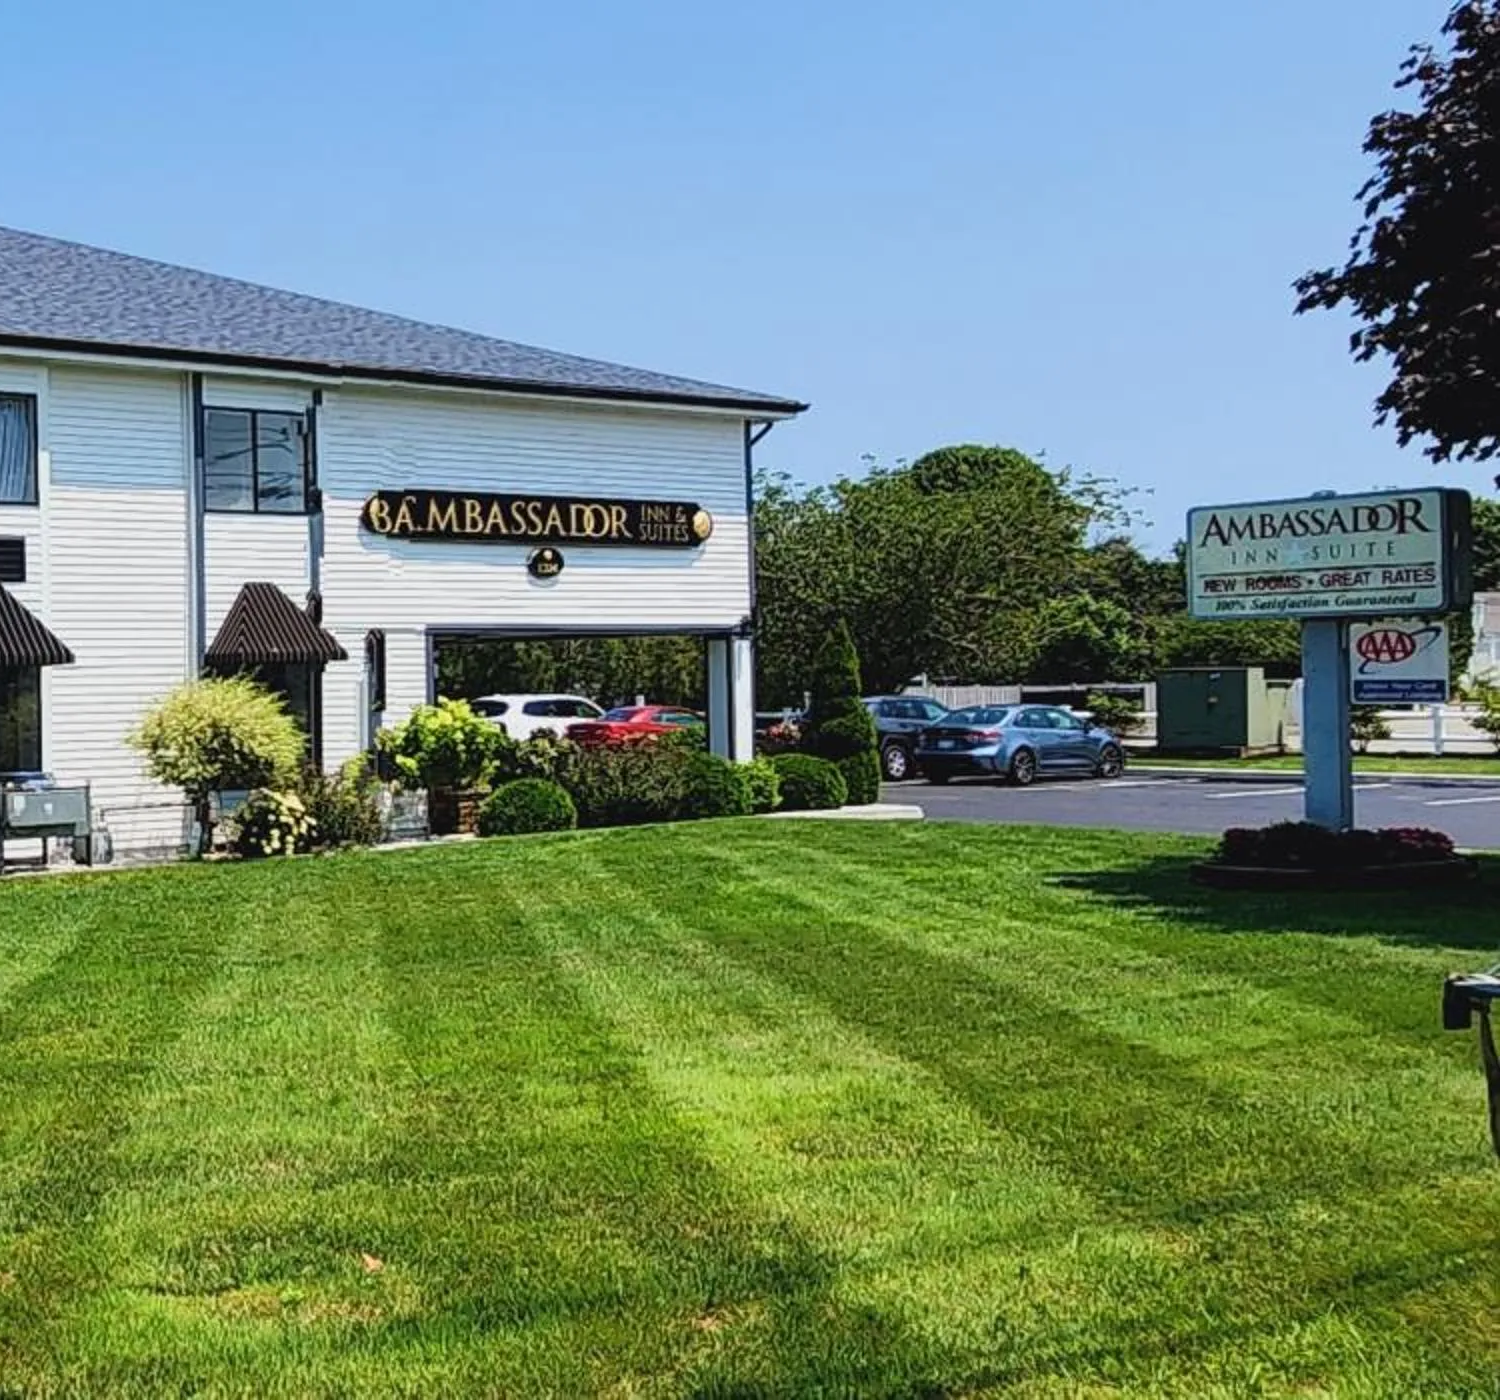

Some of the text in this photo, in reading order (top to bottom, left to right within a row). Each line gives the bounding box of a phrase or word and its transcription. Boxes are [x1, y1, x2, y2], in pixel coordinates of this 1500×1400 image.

[641, 504, 687, 523] INN &
[1200, 497, 1436, 548] AMBASSADOR
[639, 523, 690, 541] SUITES
[1231, 548, 1278, 565] INN
[1246, 575, 1301, 592] ROOMS
[1319, 571, 1371, 588] GREAT
[1381, 567, 1436, 585] RATES
[1251, 595, 1329, 614] Satisfaction
[1335, 591, 1418, 608] Guaranteed
[1361, 630, 1412, 662] AAA
